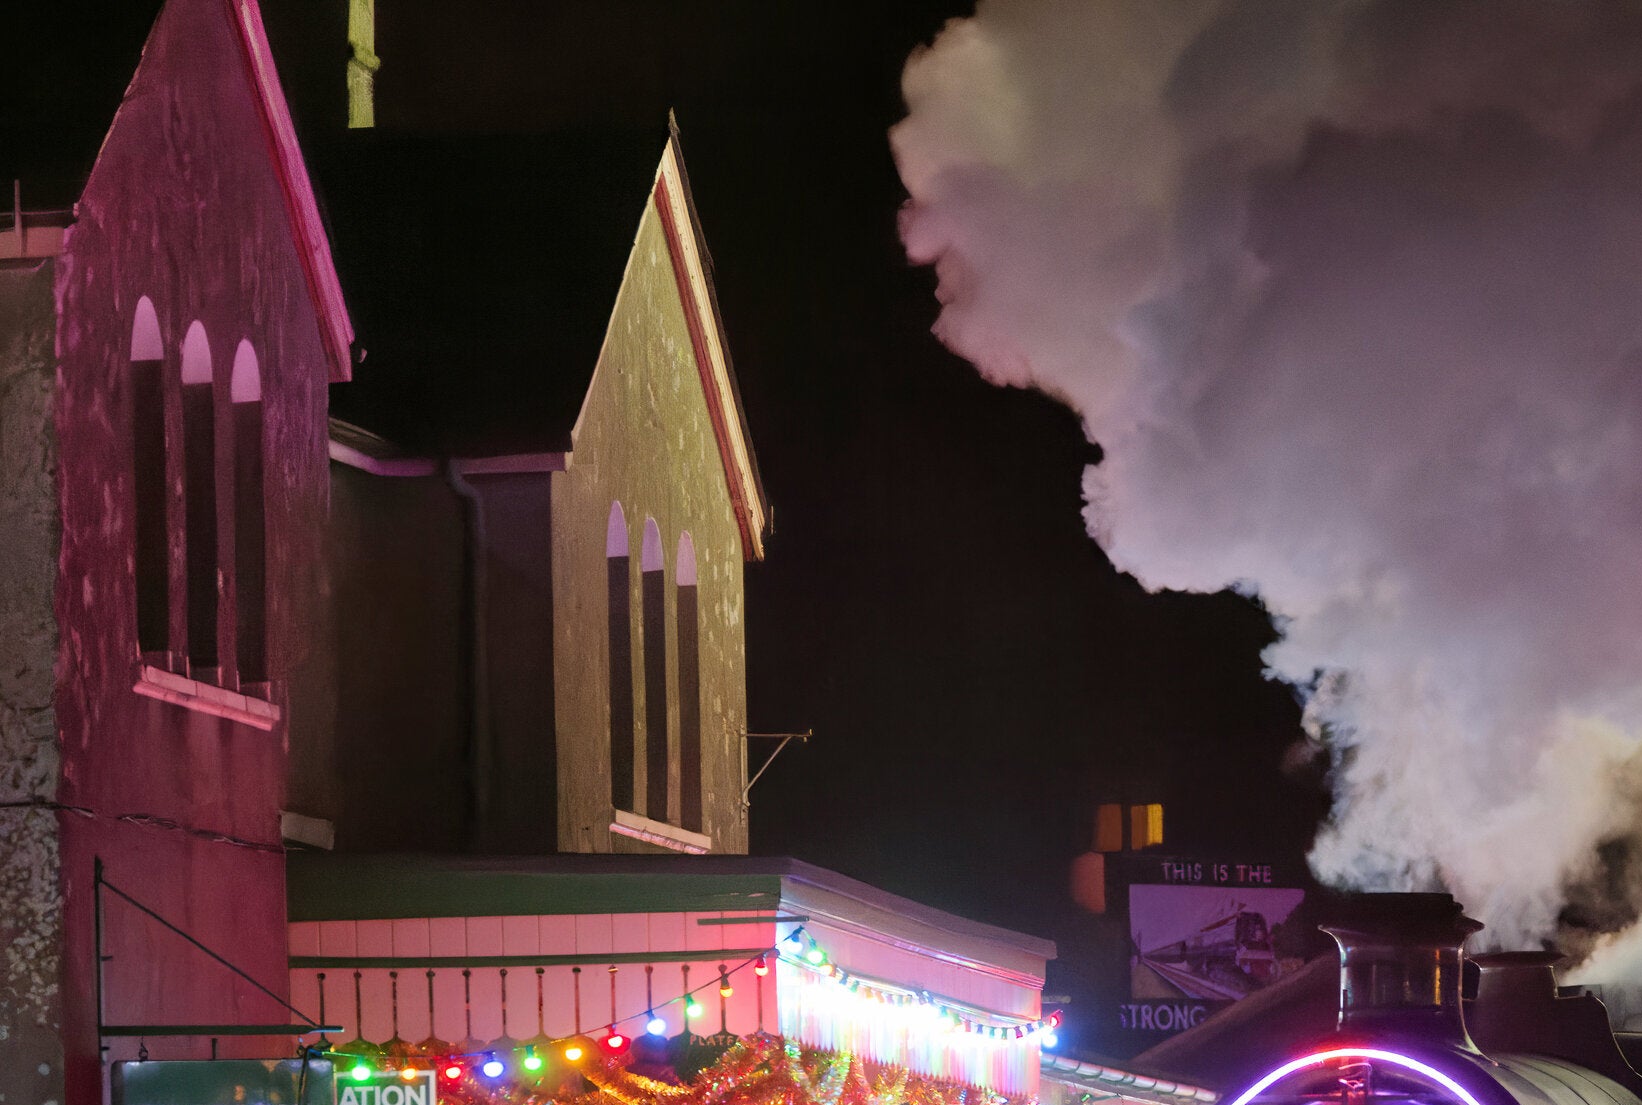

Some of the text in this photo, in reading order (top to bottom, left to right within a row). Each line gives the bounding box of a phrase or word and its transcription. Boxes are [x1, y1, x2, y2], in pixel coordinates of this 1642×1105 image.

[1161, 862, 1272, 884] THIS IS THE
